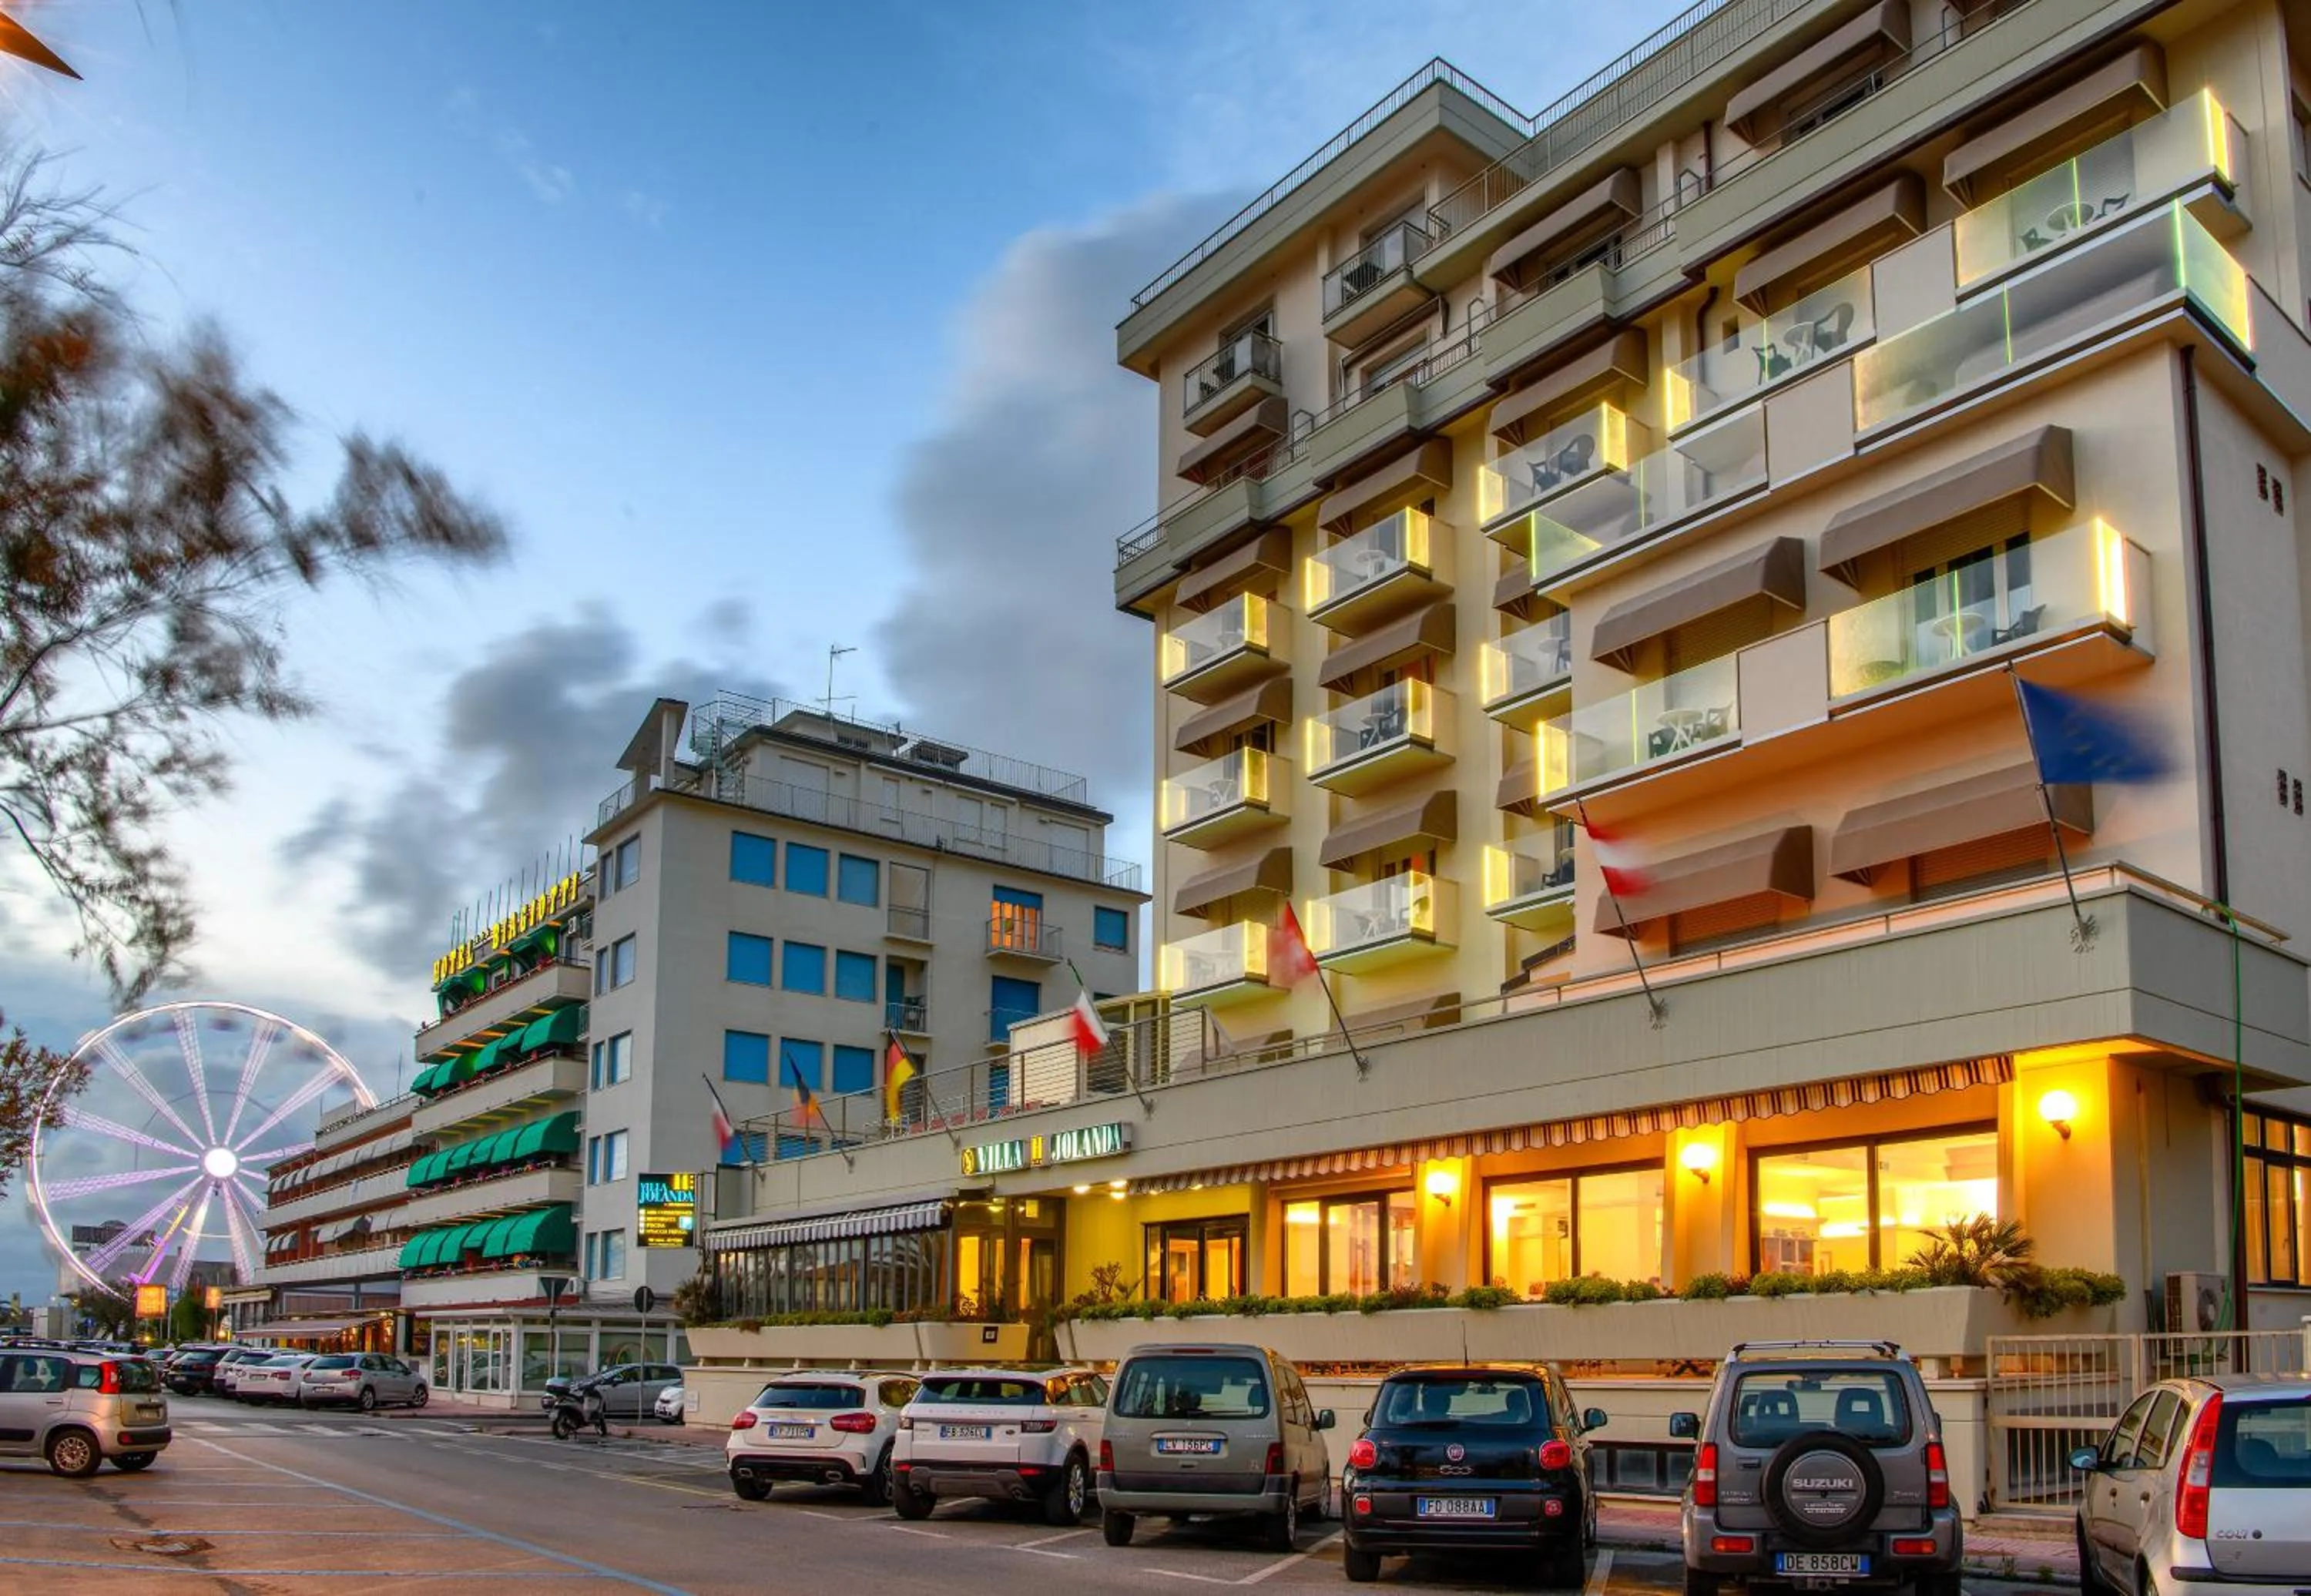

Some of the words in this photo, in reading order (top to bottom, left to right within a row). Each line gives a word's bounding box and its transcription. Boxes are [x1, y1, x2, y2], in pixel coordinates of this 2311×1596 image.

[433, 940, 474, 985] HOTEL
[491, 872, 579, 950] BIAGIOTTI
[978, 1141, 1023, 1172] VILLA
[1052, 1124, 1122, 1161] JOLANDA
[1793, 1479, 1853, 1488] SUZUKI
[1447, 1500, 1485, 1513] 088AA
[1787, 1555, 1805, 1570] DE
[1811, 1555, 1859, 1570] 858CW
